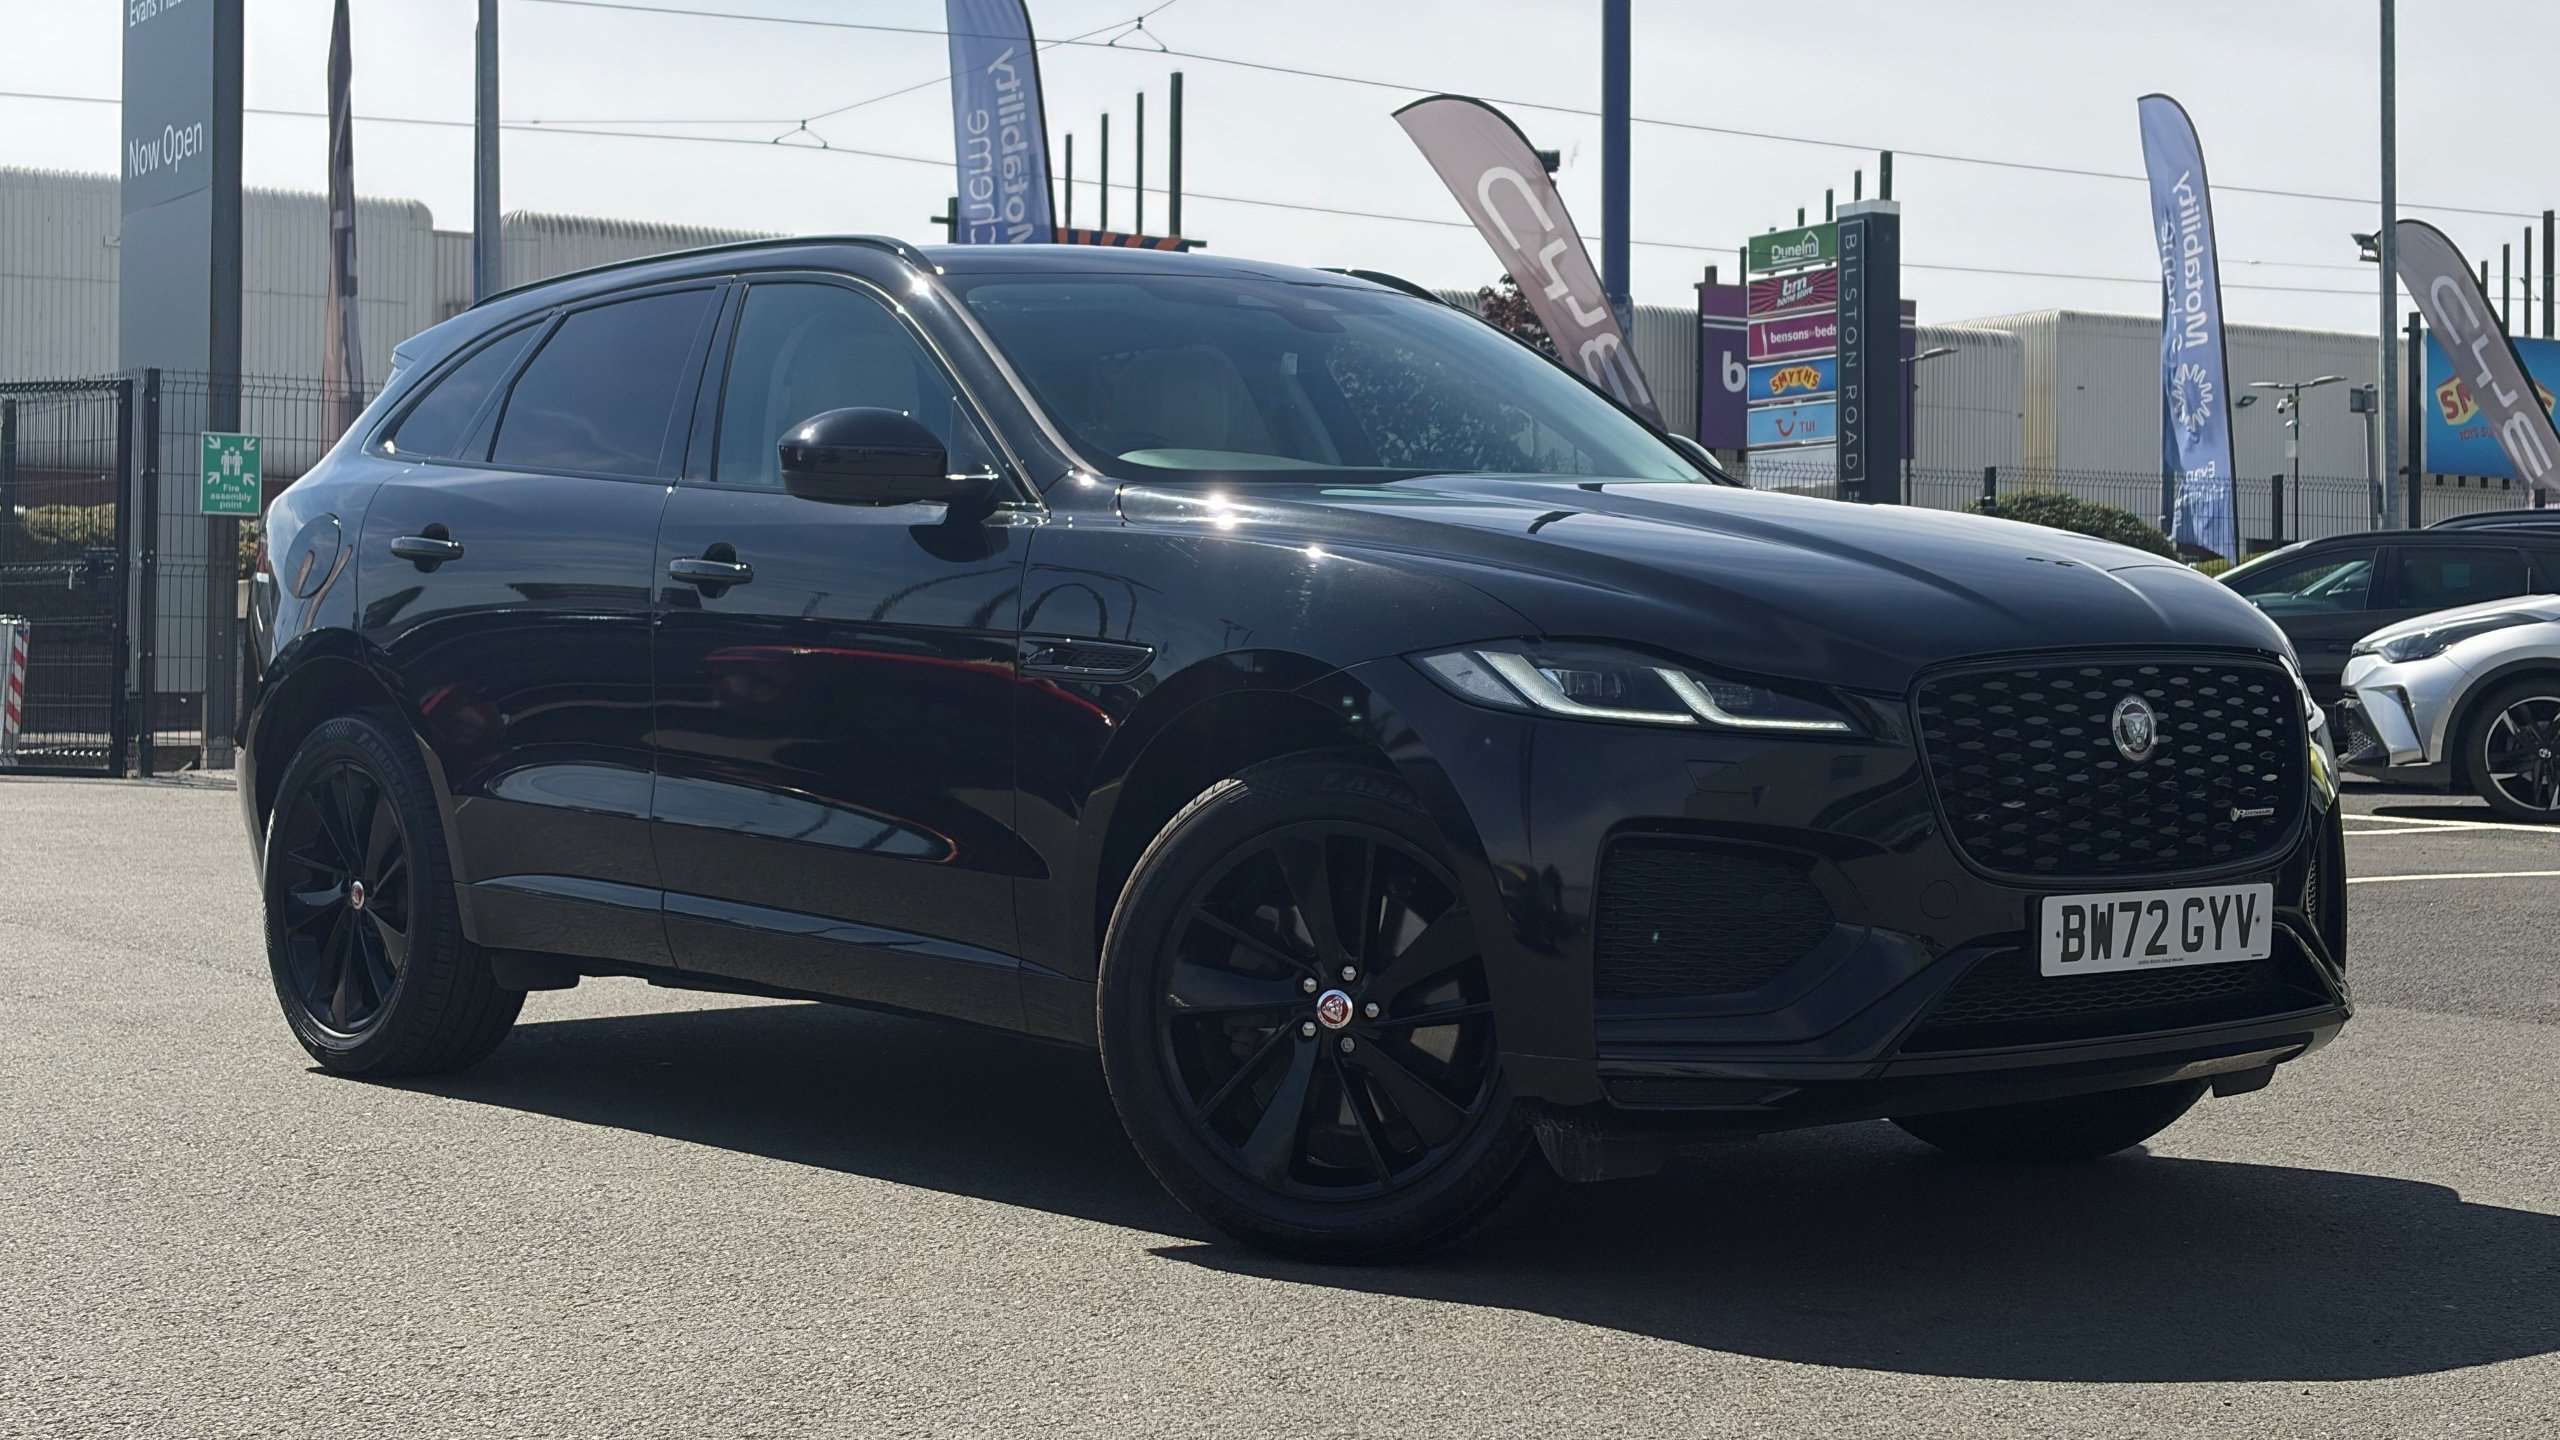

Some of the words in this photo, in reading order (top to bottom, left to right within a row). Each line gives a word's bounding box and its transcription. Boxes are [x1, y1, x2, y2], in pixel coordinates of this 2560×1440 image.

[129, 0, 157, 28] Evans
[129, 138, 160, 179] Now
[163, 122, 203, 174] Open
[1771, 236, 1818, 261] Dunelm
[1844, 233, 1857, 368] BILSTON
[1770, 331, 1809, 344] bensons
[1814, 323, 1837, 338] beds
[1770, 367, 1821, 393] SMYTHS
[1844, 385, 1858, 470] ROAD
[210, 492, 252, 503] assembly
[223, 483, 240, 492] Fire
[219, 500, 242, 510] point
[2060, 900, 2169, 963] BW72
[2181, 893, 2257, 953] GYV
